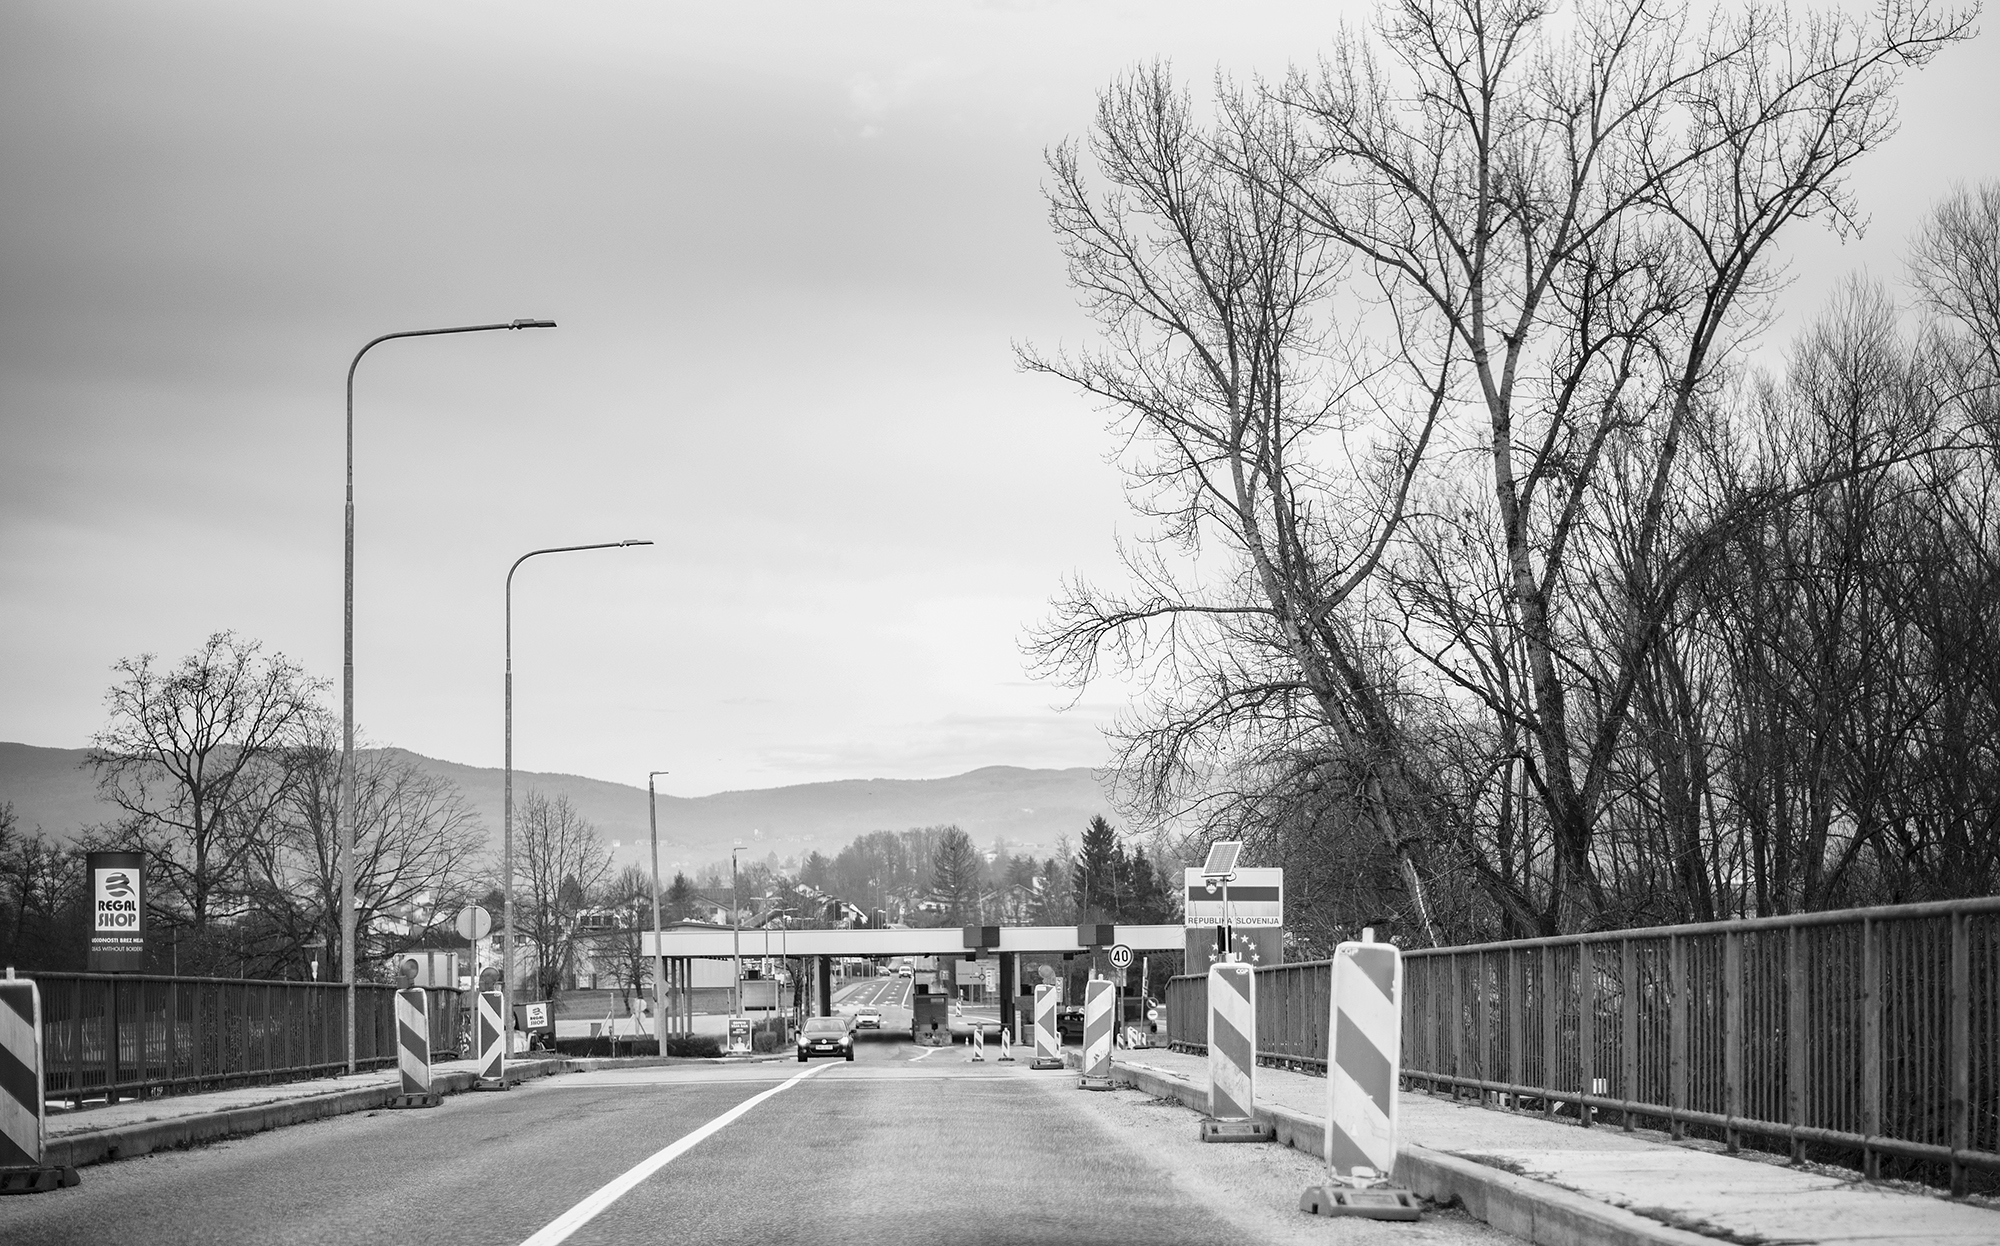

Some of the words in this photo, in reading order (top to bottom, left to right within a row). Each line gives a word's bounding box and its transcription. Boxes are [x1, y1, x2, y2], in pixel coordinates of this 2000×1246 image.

[98, 900, 136, 911] REGAL
[98, 913, 136, 927] SHOP
[1236, 917, 1279, 925] SLOVENIJA
[1113, 950, 1128, 962] 40
